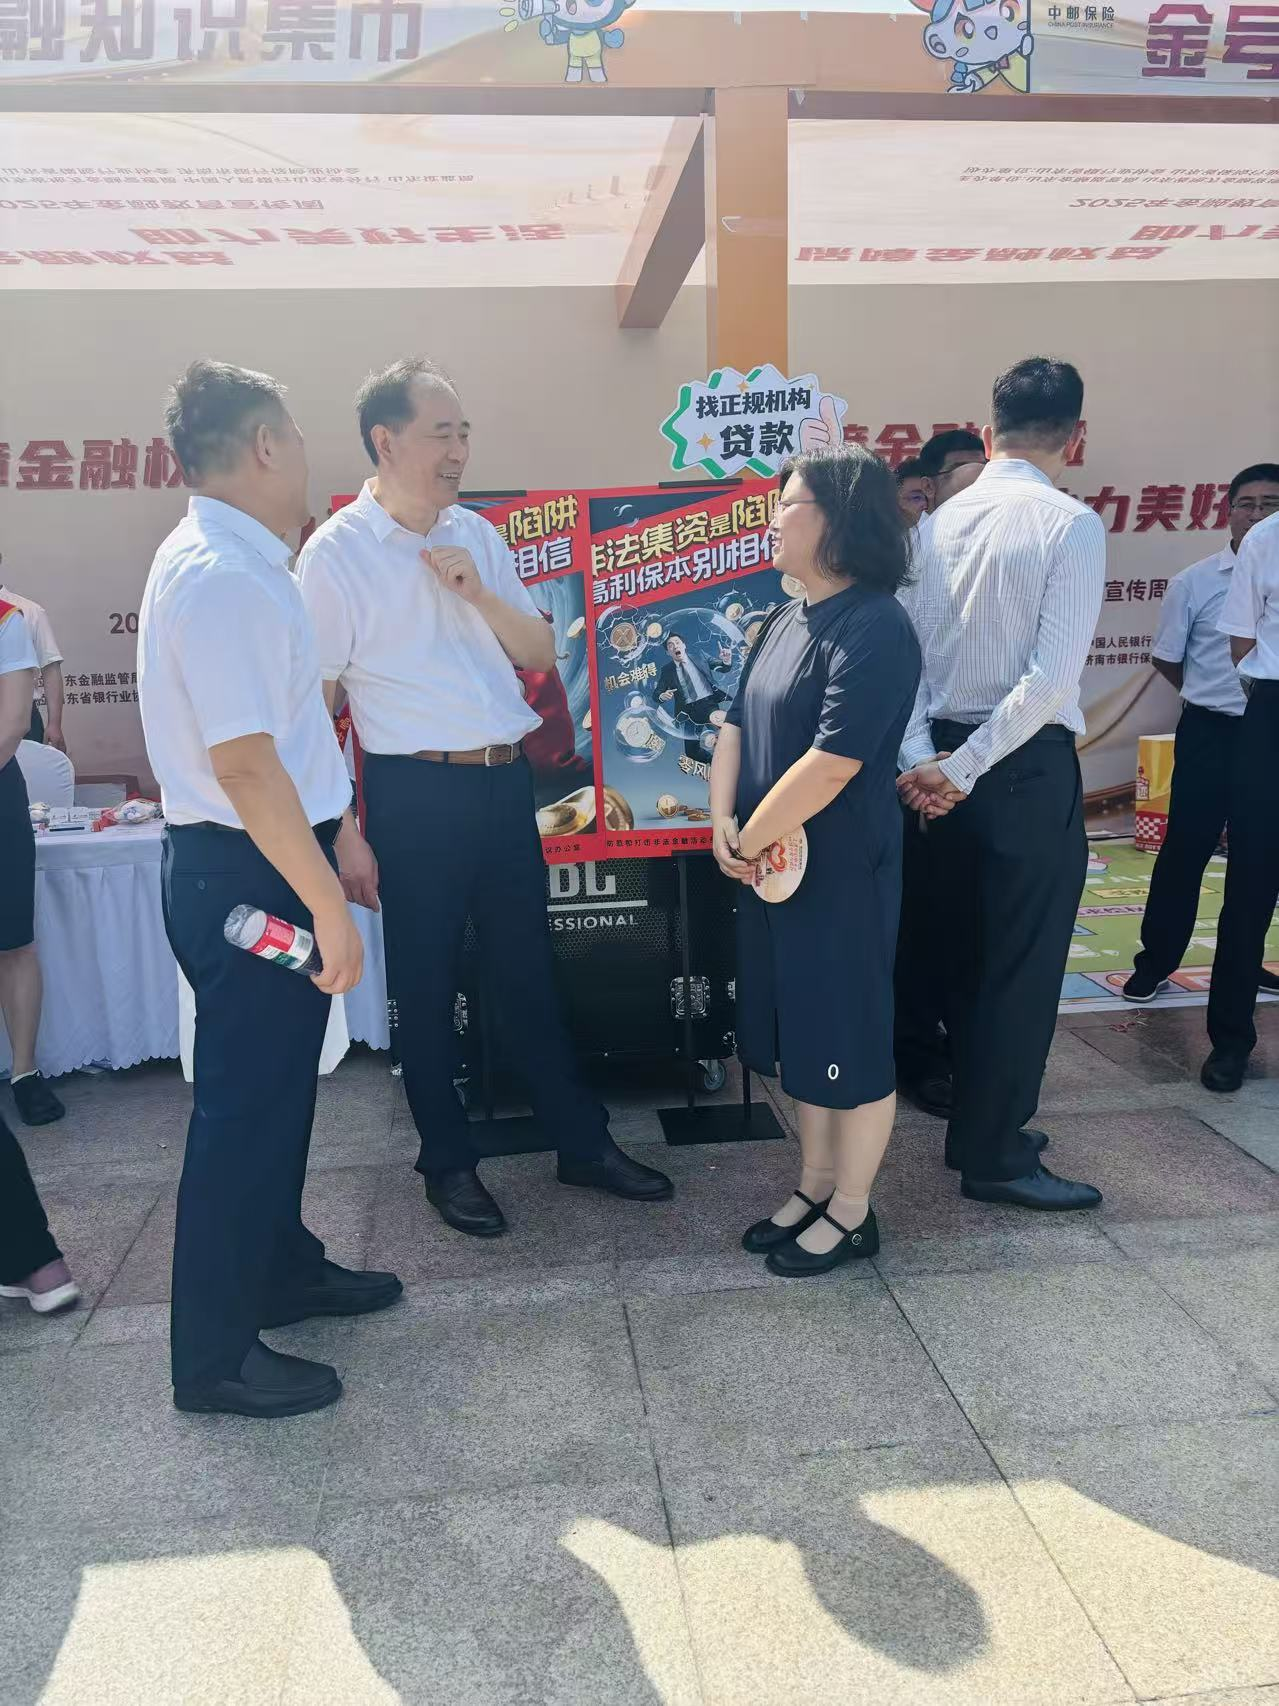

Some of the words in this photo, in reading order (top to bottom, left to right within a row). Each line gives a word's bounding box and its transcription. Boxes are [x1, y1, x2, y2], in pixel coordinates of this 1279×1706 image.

[1047, 21, 1066, 29] CHINA
[1066, 21, 1081, 29] POST
[1081, 21, 1114, 30] INSURANCE
[1048, 5, 1115, 21] 中邮保险
[696, 387, 811, 419] 找正规机构
[720, 420, 794, 460] 贷款
[0, 437, 195, 490] 金融权
[1064, 483, 1231, 533] 力美好
[512, 536, 573, 580] 相信
[1104, 579, 1169, 602] 宣传周
[109, 612, 139, 634] 20
[1091, 635, 1152, 649] 国人民银行
[604, 662, 657, 692] 机会难得
[62, 689, 140, 705] 东省银行业
[679, 753, 712, 781] 零风
[549, 914, 639, 931] SSIONAL
